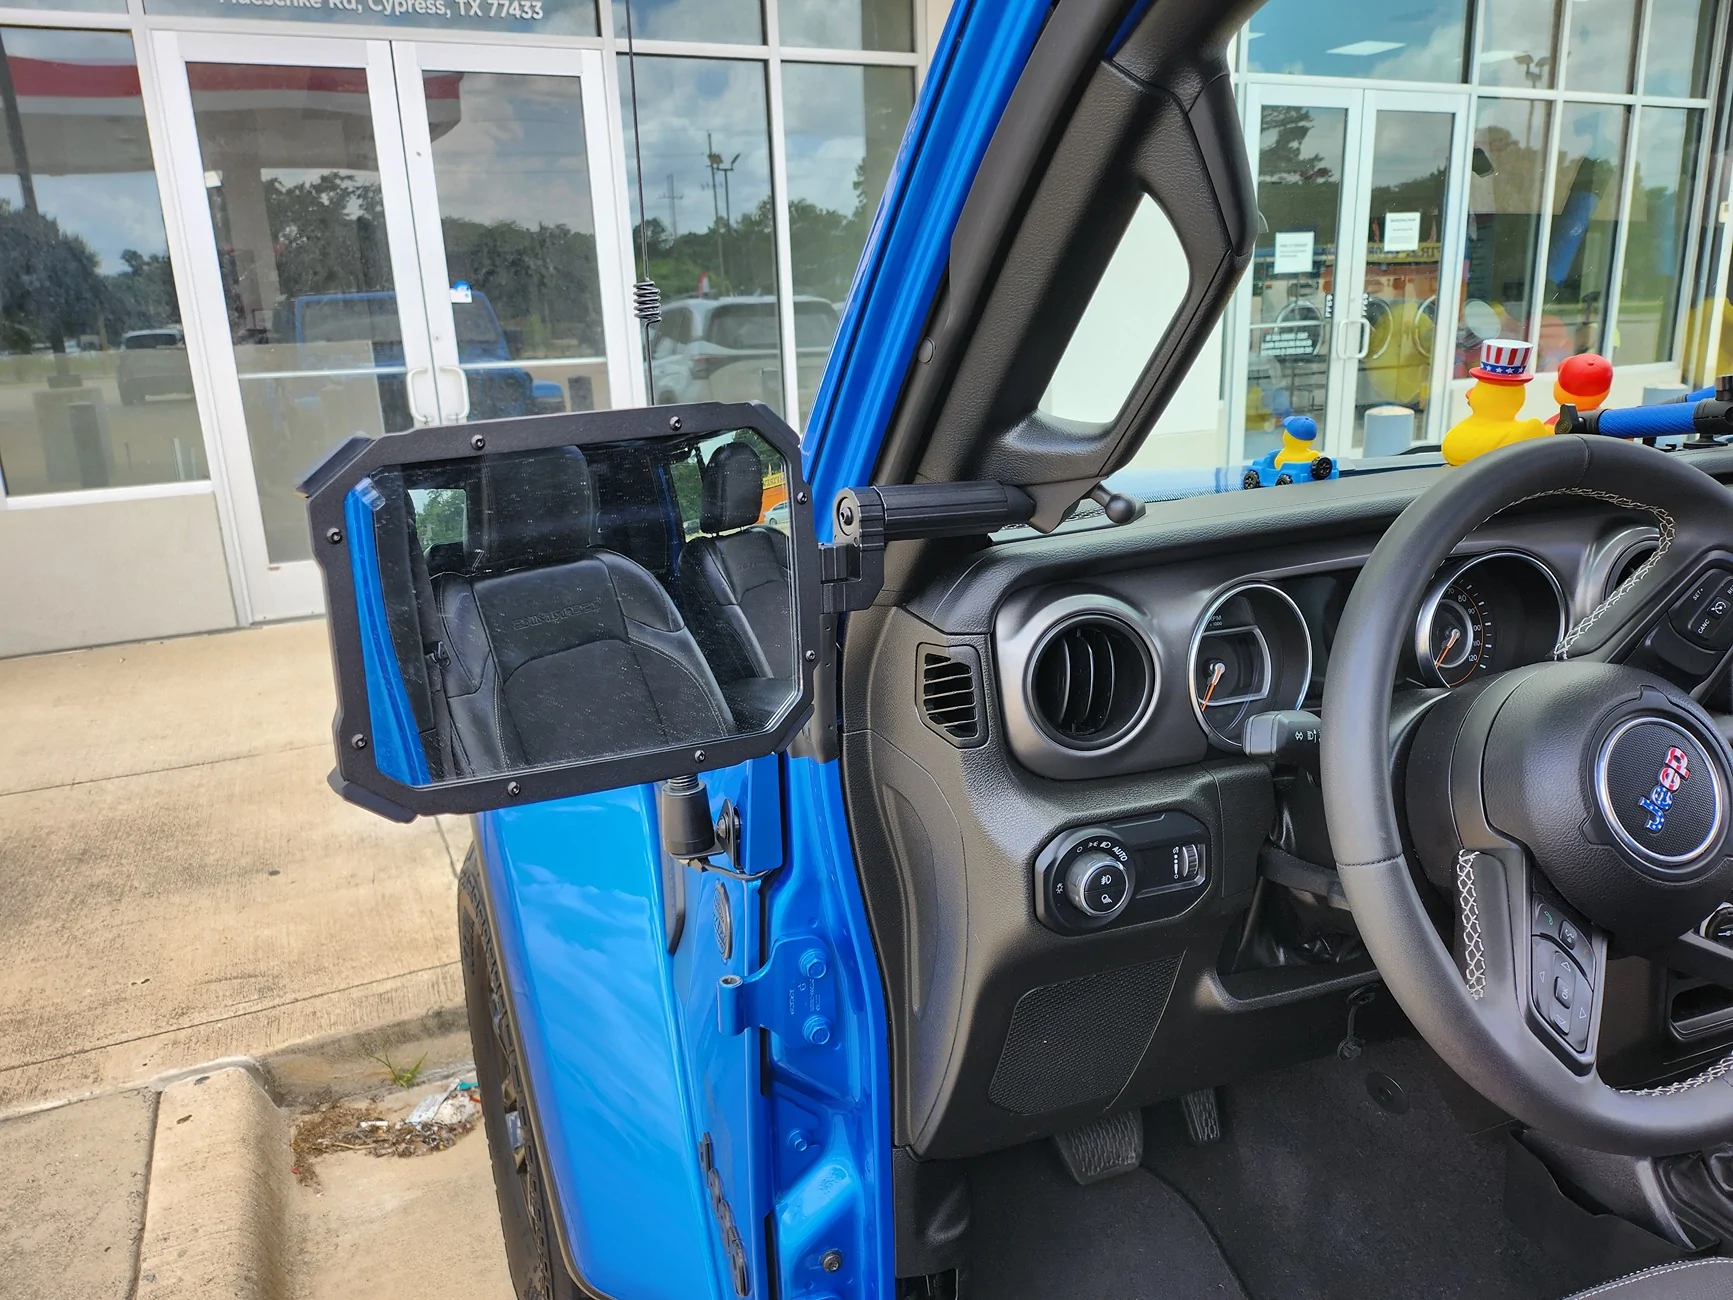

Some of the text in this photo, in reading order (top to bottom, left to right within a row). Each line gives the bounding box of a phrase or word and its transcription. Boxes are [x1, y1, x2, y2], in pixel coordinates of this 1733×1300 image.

[219, 0, 322, 8] chke
[368, 0, 451, 17] Cypress,
[454, 0, 483, 17] TX
[487, 0, 543, 20] 77433
[1457, 594, 1467, 602] 80
[1697, 618, 1710, 634] CANC
[1468, 654, 1478, 662] 120
[1639, 746, 1691, 831] Jeep
[1112, 846, 1128, 861] AUTO
[1561, 986, 1569, 1000] OK
